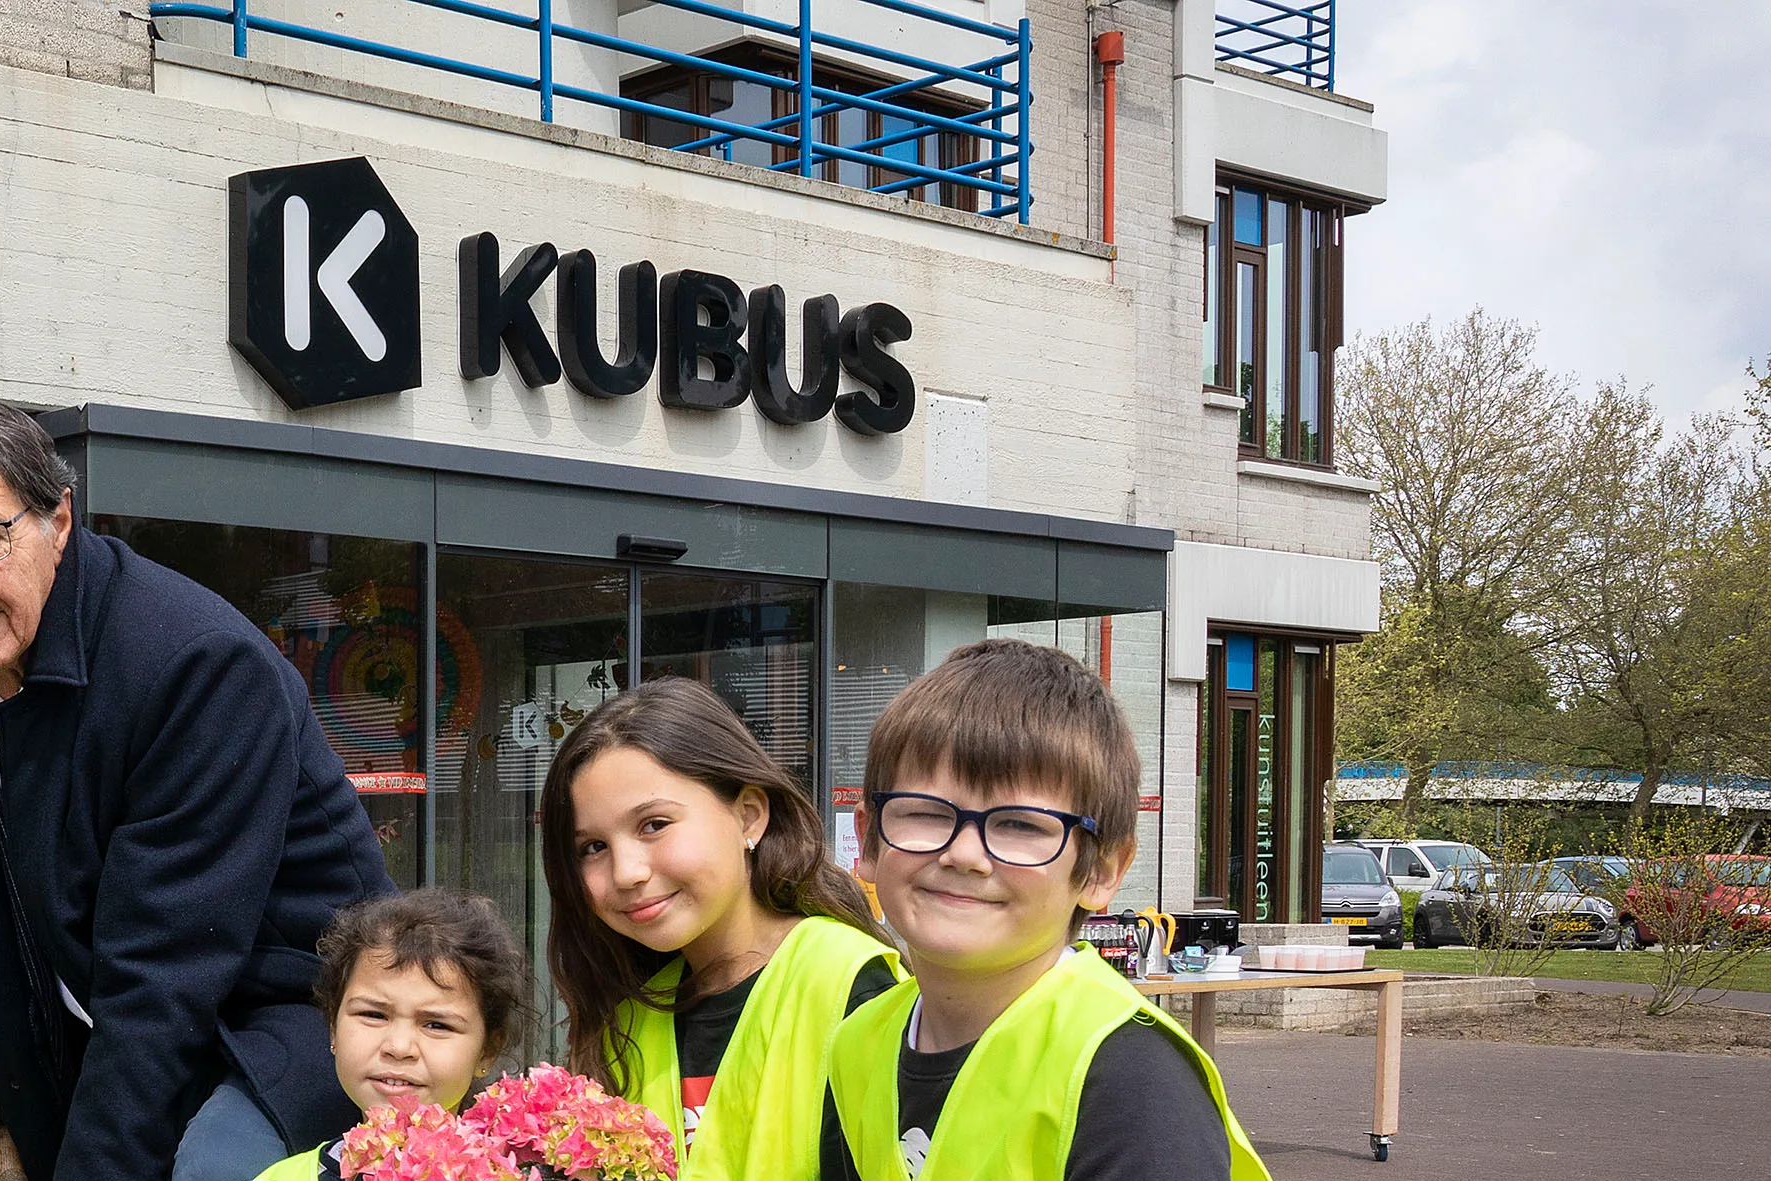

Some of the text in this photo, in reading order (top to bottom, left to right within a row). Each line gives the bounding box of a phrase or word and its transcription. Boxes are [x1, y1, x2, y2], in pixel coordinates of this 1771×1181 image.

[283, 194, 387, 363] K
[456, 230, 916, 436] KUBUS
[1256, 714, 1276, 921] kunstuitleen
